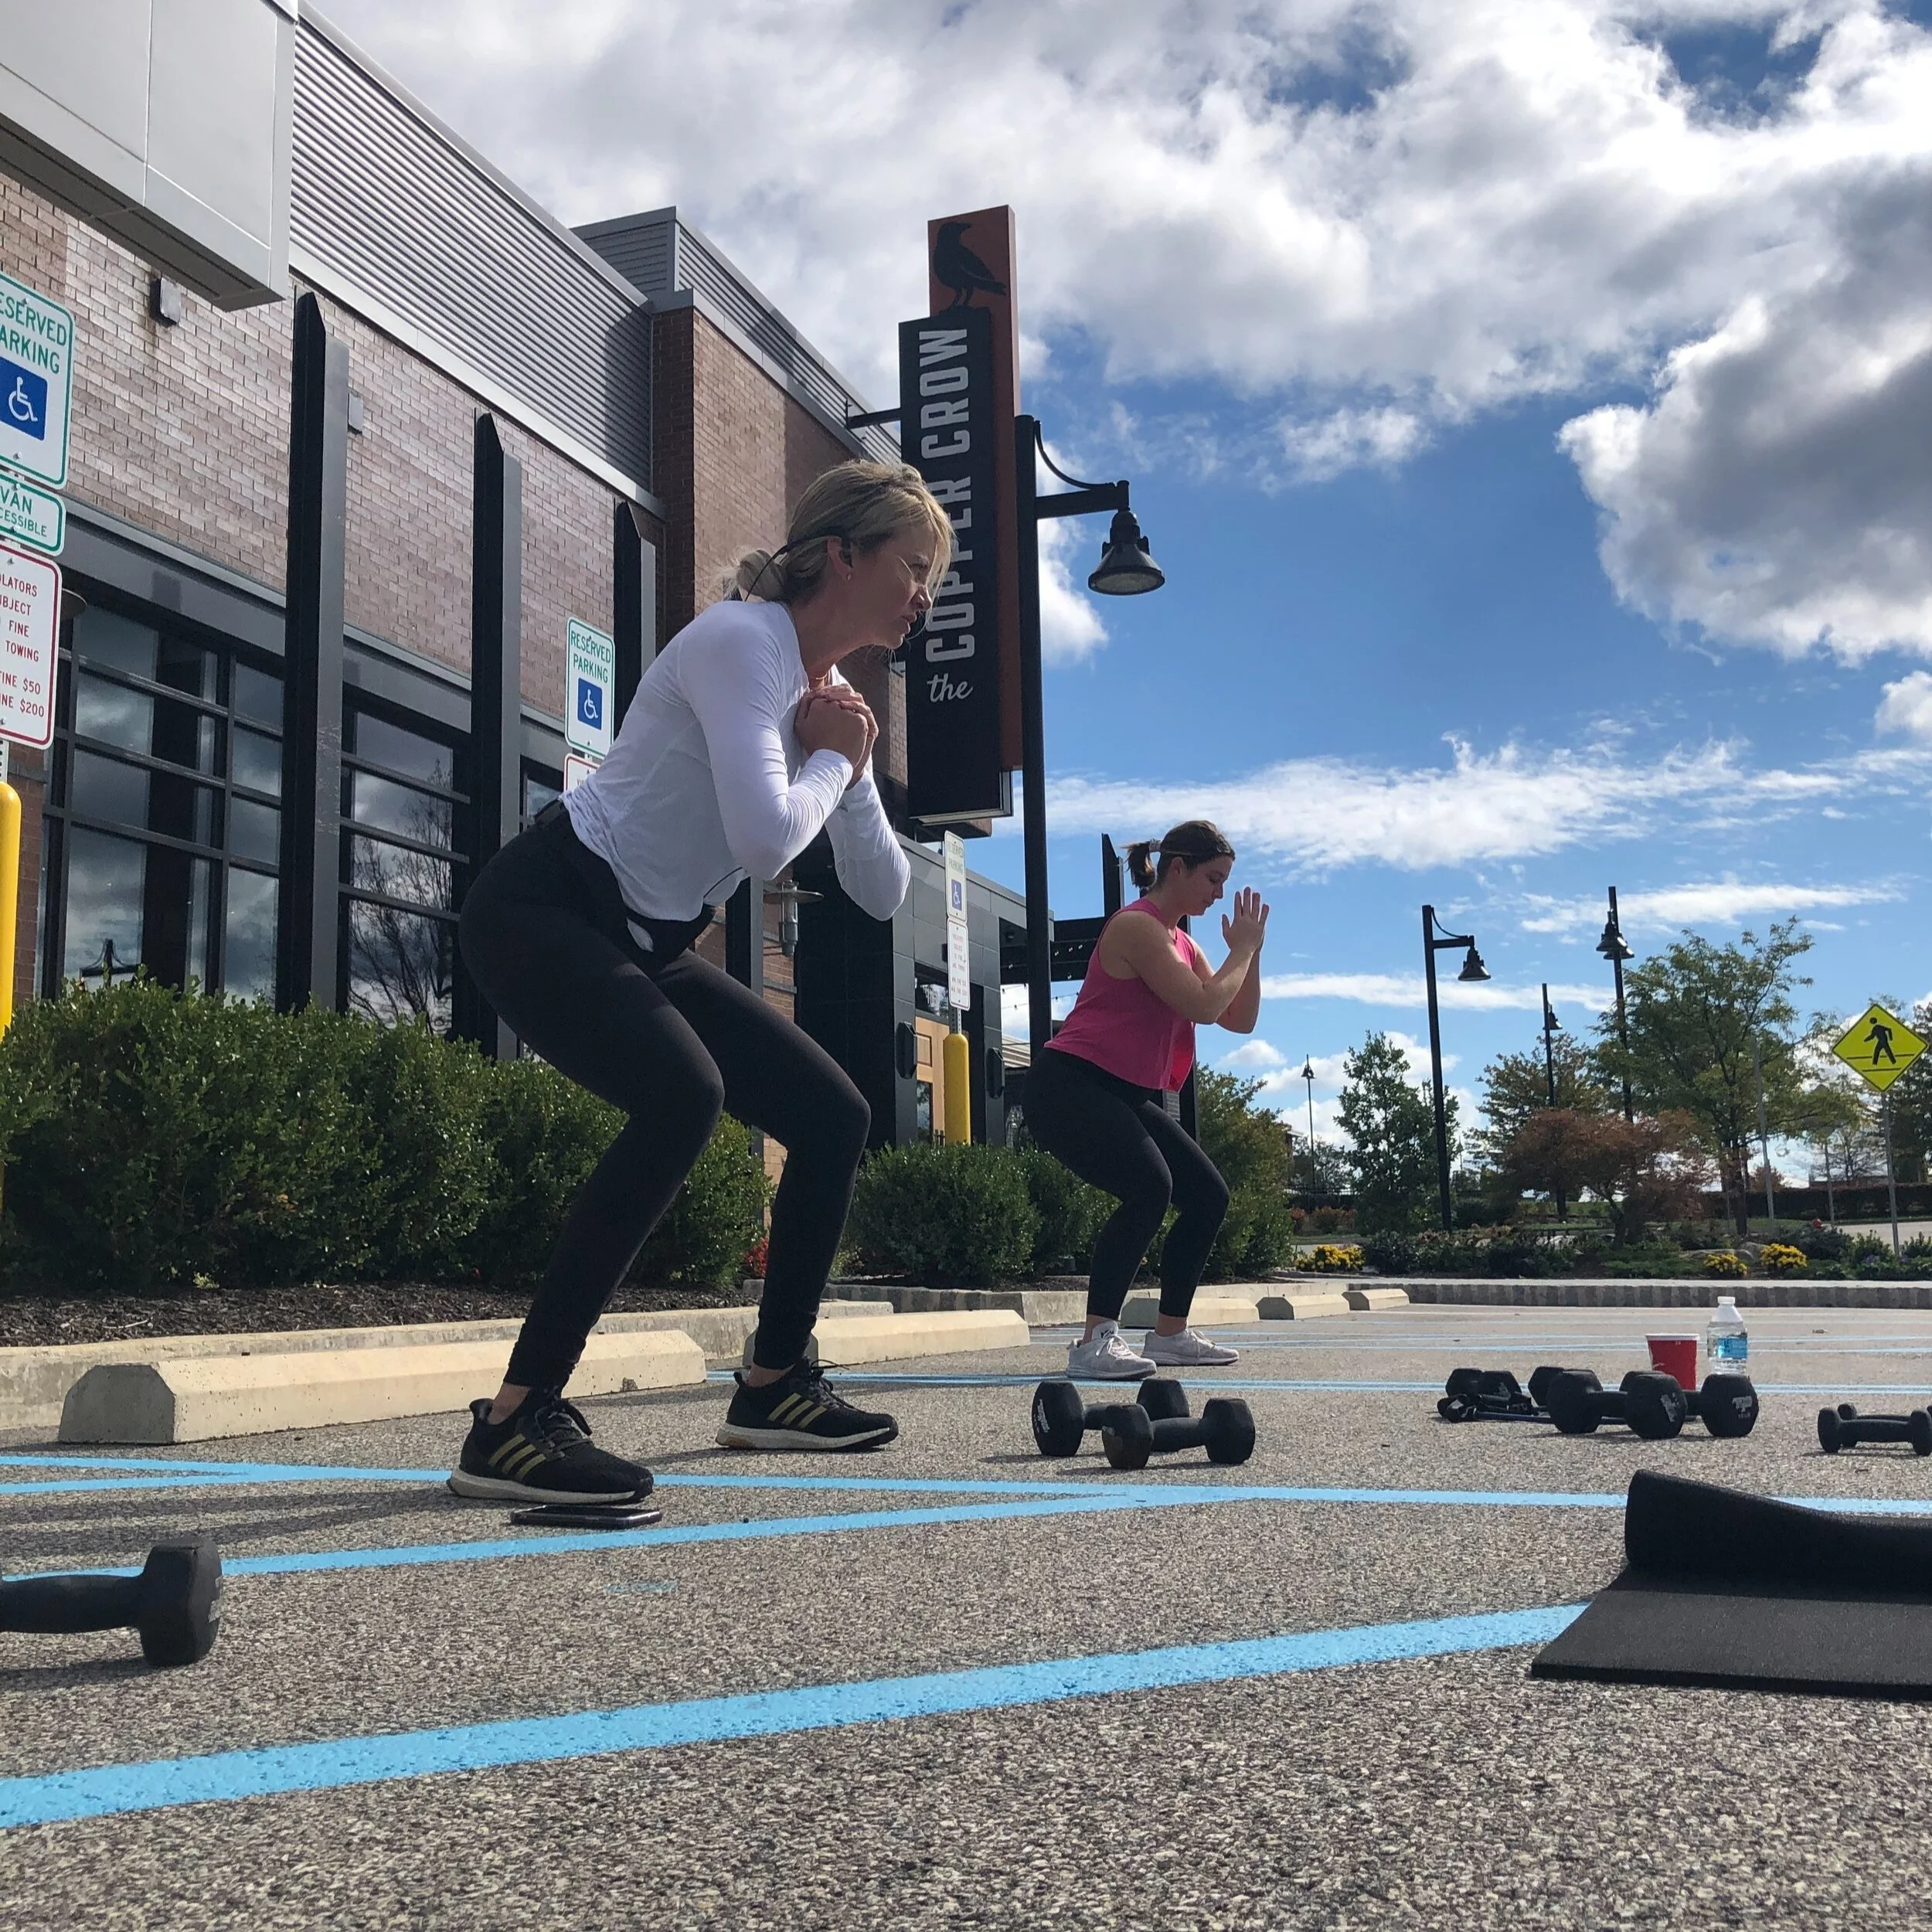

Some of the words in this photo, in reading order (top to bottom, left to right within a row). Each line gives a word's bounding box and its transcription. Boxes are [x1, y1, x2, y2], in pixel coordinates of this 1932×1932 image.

[919, 328, 971, 459] CROW
[0, 485, 32, 515] VAN
[0, 507, 47, 537] ESSIBLE
[0, 573, 37, 597] LATORS
[0, 594, 31, 617] BJECT
[9, 619, 29, 638] FINE
[5, 640, 39, 662] TOWING
[571, 630, 611, 664] RESERVED
[573, 653, 608, 683] PARKING
[22, 677, 41, 695] $50
[927, 673, 974, 702] the
[0, 692, 14, 709] NE
[19, 698, 45, 718] $200
